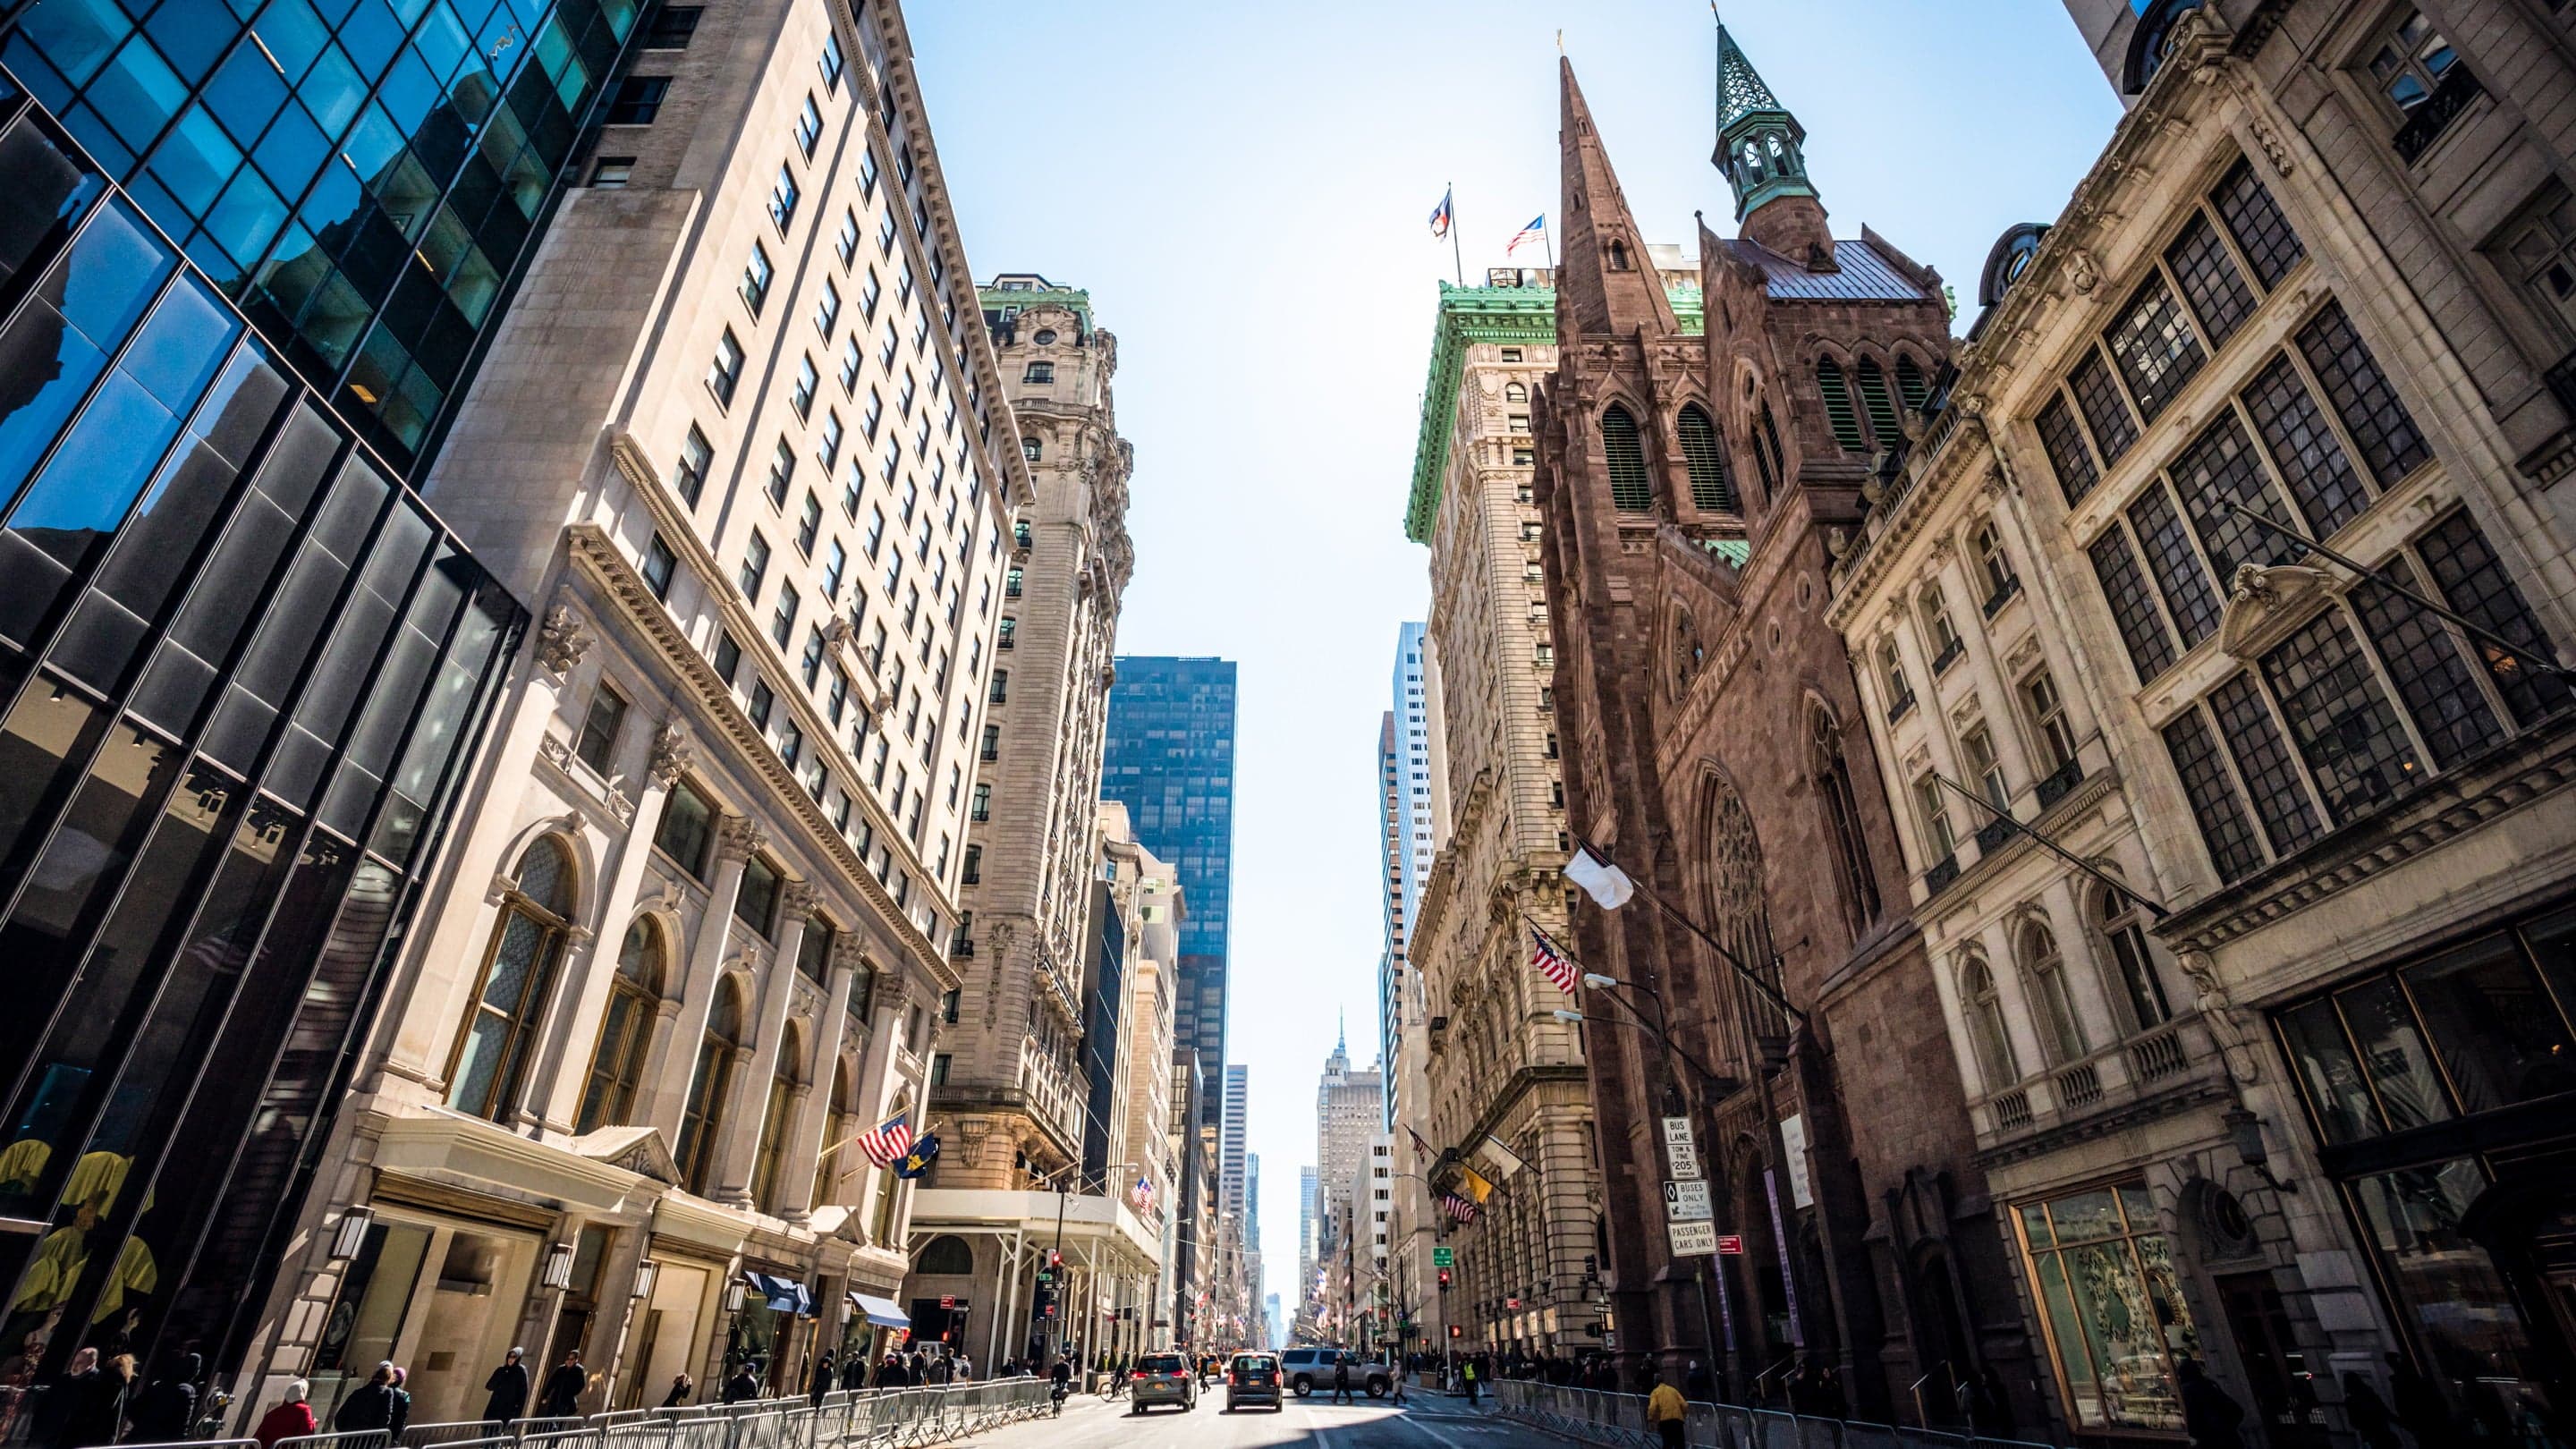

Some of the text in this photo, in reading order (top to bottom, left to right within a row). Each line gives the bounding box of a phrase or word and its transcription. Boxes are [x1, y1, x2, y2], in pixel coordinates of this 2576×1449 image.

[1669, 1121, 1685, 1131] BUS
[1669, 1132, 1689, 1142] LANE
[1680, 1182, 1704, 1192] BUSES
[1682, 1194, 1704, 1203] ONLY
[1672, 1224, 1711, 1237] PASSENGER
[1674, 1239, 1693, 1250] CARS
[1696, 1237, 1714, 1248] ONLY
